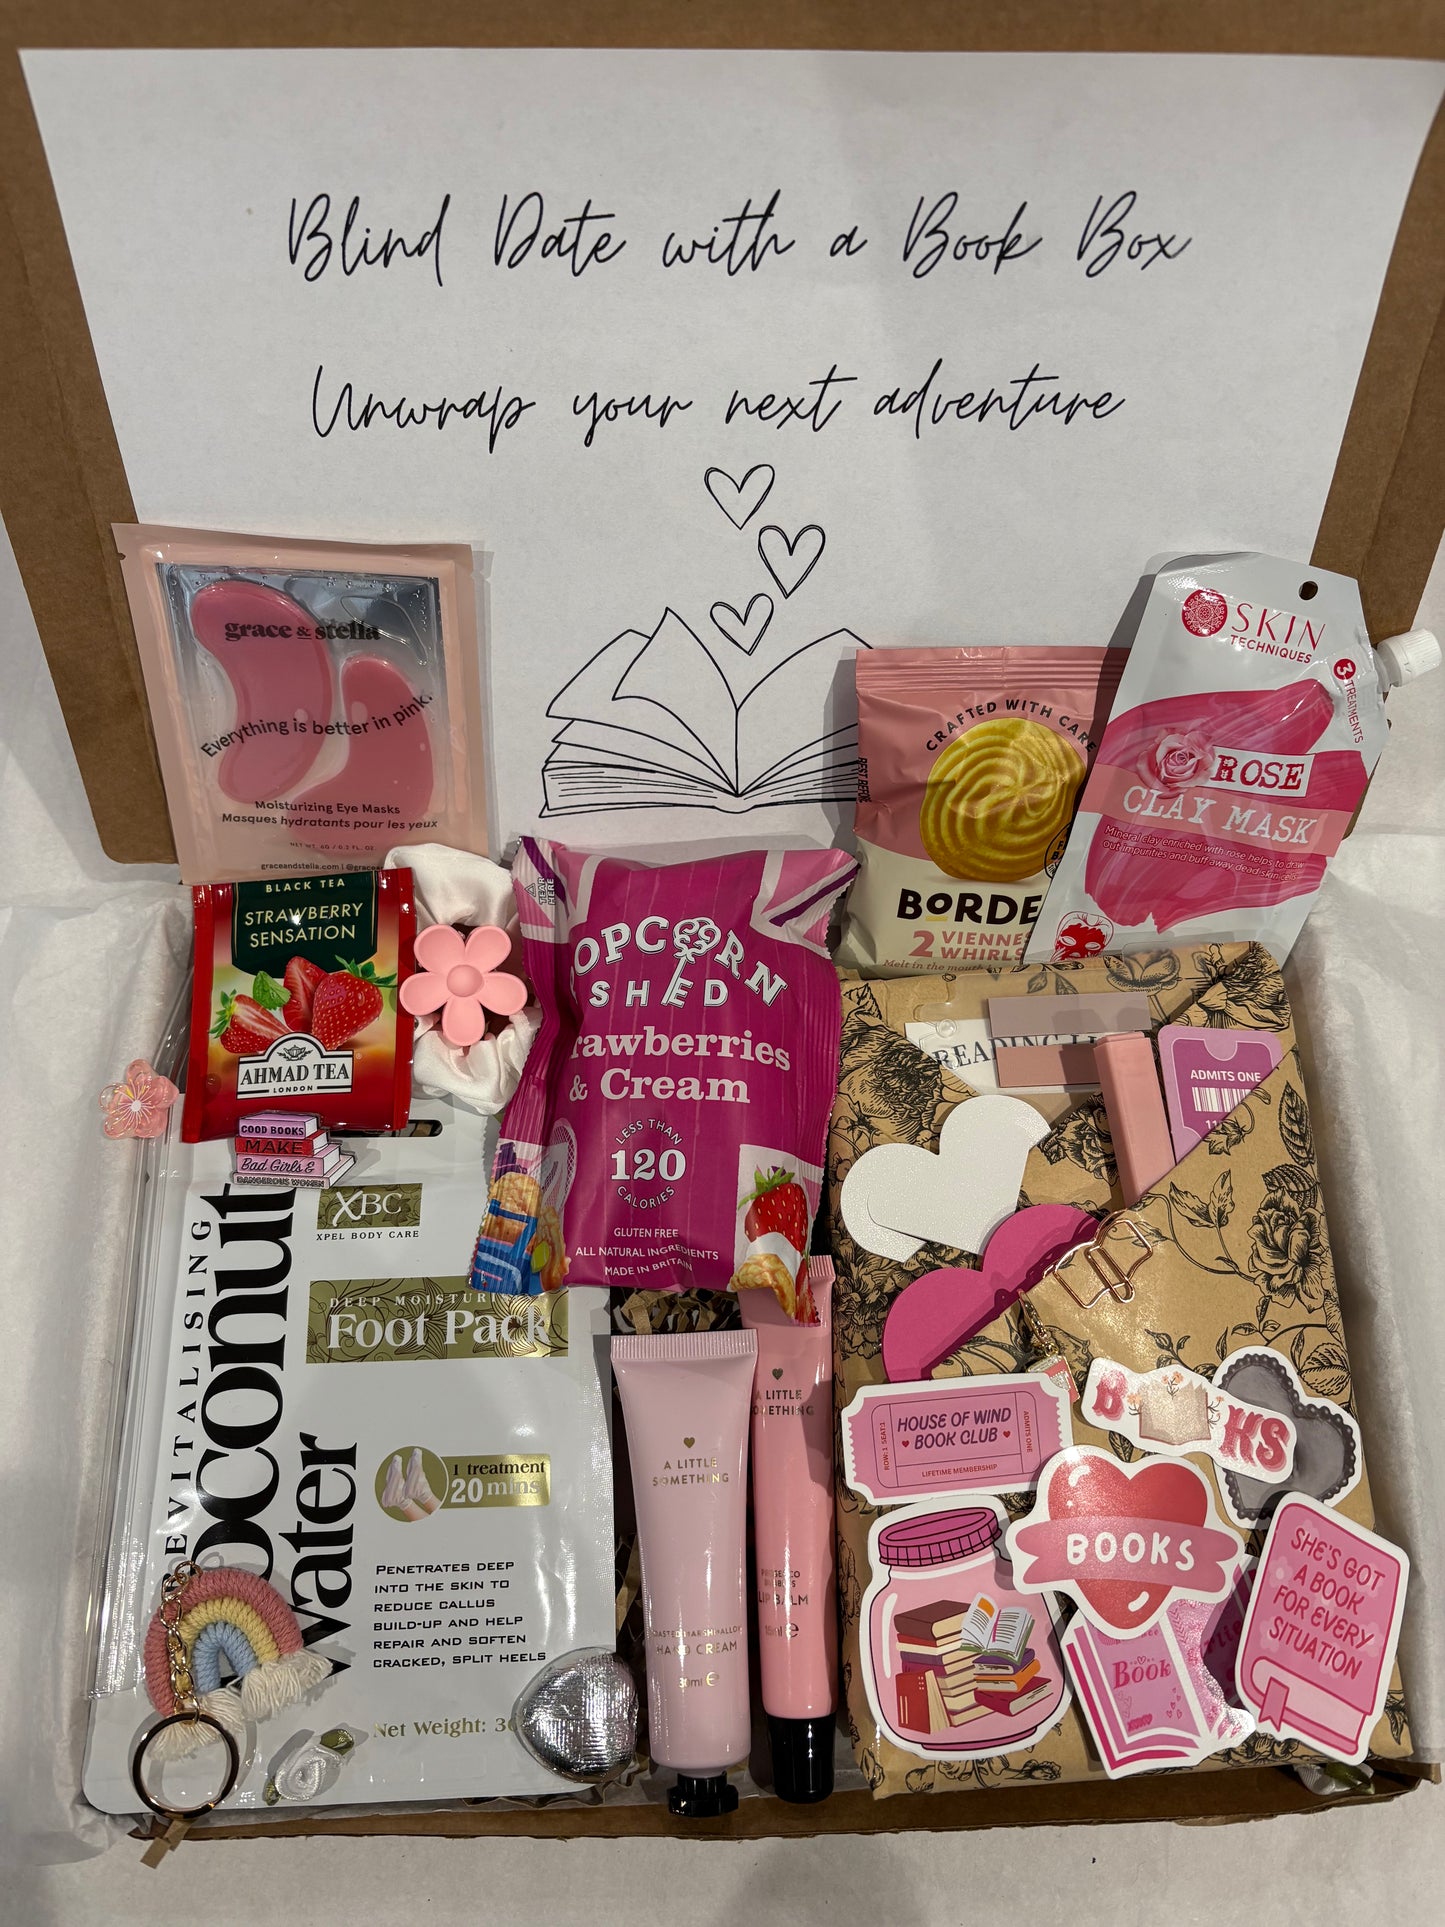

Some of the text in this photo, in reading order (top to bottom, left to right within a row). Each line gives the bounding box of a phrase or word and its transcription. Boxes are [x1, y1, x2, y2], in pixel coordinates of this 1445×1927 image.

[289, 188, 1192, 287] Blind Date with a Book Box
[312, 358, 1125, 454] Unwrap your next adventure
[224, 618, 382, 642] grace & stella
[1231, 602, 1326, 651] SKIN
[1230, 634, 1313, 664] TECHNIQUES
[1336, 661, 1353, 676] 3
[1344, 679, 1364, 744] TREATMENTS
[200, 693, 434, 758] Everything is better in pink.
[926, 699, 1098, 753] CRAFTED WITH CARE
[1210, 754, 1305, 790] ROSE
[254, 800, 401, 815] Moisturizing Eye Masks
[1122, 785, 1318, 845] CLAY MASK
[221, 813, 438, 832] Masques hydratants pour les yeux
[1104, 825, 1305, 869] Mineral clay enriched with rose helps to draw
[261, 862, 340, 872] graceandstella.com
[1102, 839, 1121, 851] out
[1122, 841, 1168, 860] impurities
[1169, 850, 1187, 862] and
[1188, 853, 1209, 866] buff
[1209, 857, 1234, 872] away
[1234, 862, 1260, 875] dead
[1260, 869, 1279, 880] skin
[265, 878, 346, 893] BLACK TEA
[538, 877, 547, 905] TEAR
[547, 878, 556, 906] HERE
[244, 901, 364, 927] STRAWBERRY
[249, 924, 357, 949] SENSATION
[908, 930, 936, 958] 2
[882, 959, 945, 971] Melt in the
[588, 976, 729, 1009] SHED
[240, 1063, 350, 1086] AHMAD TEA
[569, 1067, 751, 1105] & Cream
[1190, 1069, 1262, 1082] ADMITS ONE
[273, 1085, 313, 1093] LONDON
[270, 1125, 304, 1136] BOOKS
[615, 1118, 683, 1146] LESS THAN
[245, 1139, 304, 1155] MAKE
[240, 1157, 268, 1172] Bad
[270, 1158, 303, 1174] Girls
[611, 1148, 686, 1182] 120
[236, 1175, 325, 1188] DANGEROUS WOMEN
[331, 1189, 403, 1228] XBC
[616, 1185, 676, 1210] CALORIES
[316, 1230, 420, 1241] XPEL BODY CARE
[613, 1227, 680, 1239] GLUTEN FREE
[575, 1243, 720, 1261] ALL NATURAL INGREDIENTS
[604, 1257, 693, 1277] MADE IN BRITAIN
[330, 1296, 382, 1308] DEEP
[327, 1306, 551, 1349] Foot Pack
[766, 1389, 803, 1401] LITTLE
[897, 1407, 1012, 1433] HOUSE OF WIND
[1023, 1410, 1034, 1453] ADMITS ONE
[914, 1427, 998, 1450] BOOK CLUB
[452, 1460, 546, 1476] 1 treatment
[663, 1457, 718, 1470] A LITTLE
[921, 1463, 998, 1478] LIFETIME MEMBERSHIP
[450, 1477, 541, 1504] 20 mins
[652, 1472, 730, 1487] SOMETHING
[1065, 1530, 1196, 1572] BOOKS
[1290, 1527, 1386, 1592] SHE'S GOT
[476, 1561, 515, 1572] DEEP
[374, 1579, 510, 1594] INTO THE SKIN TO
[1293, 1564, 1365, 1616] A BOOK
[373, 1598, 496, 1613] REDUCE CALLUS
[1273, 1584, 1375, 1650] FOR EVERY
[373, 1616, 524, 1632] BUILD-UP AND HELP
[373, 1634, 527, 1650] REPAIR AND SOFTEN
[696, 1640, 738, 1656] CREAM
[1269, 1615, 1363, 1680] SITUATION
[372, 1651, 547, 1669] CRACKED, SPLIT HEELS
[1111, 1659, 1172, 1690] Book
[373, 1717, 487, 1738] Net Weight:
